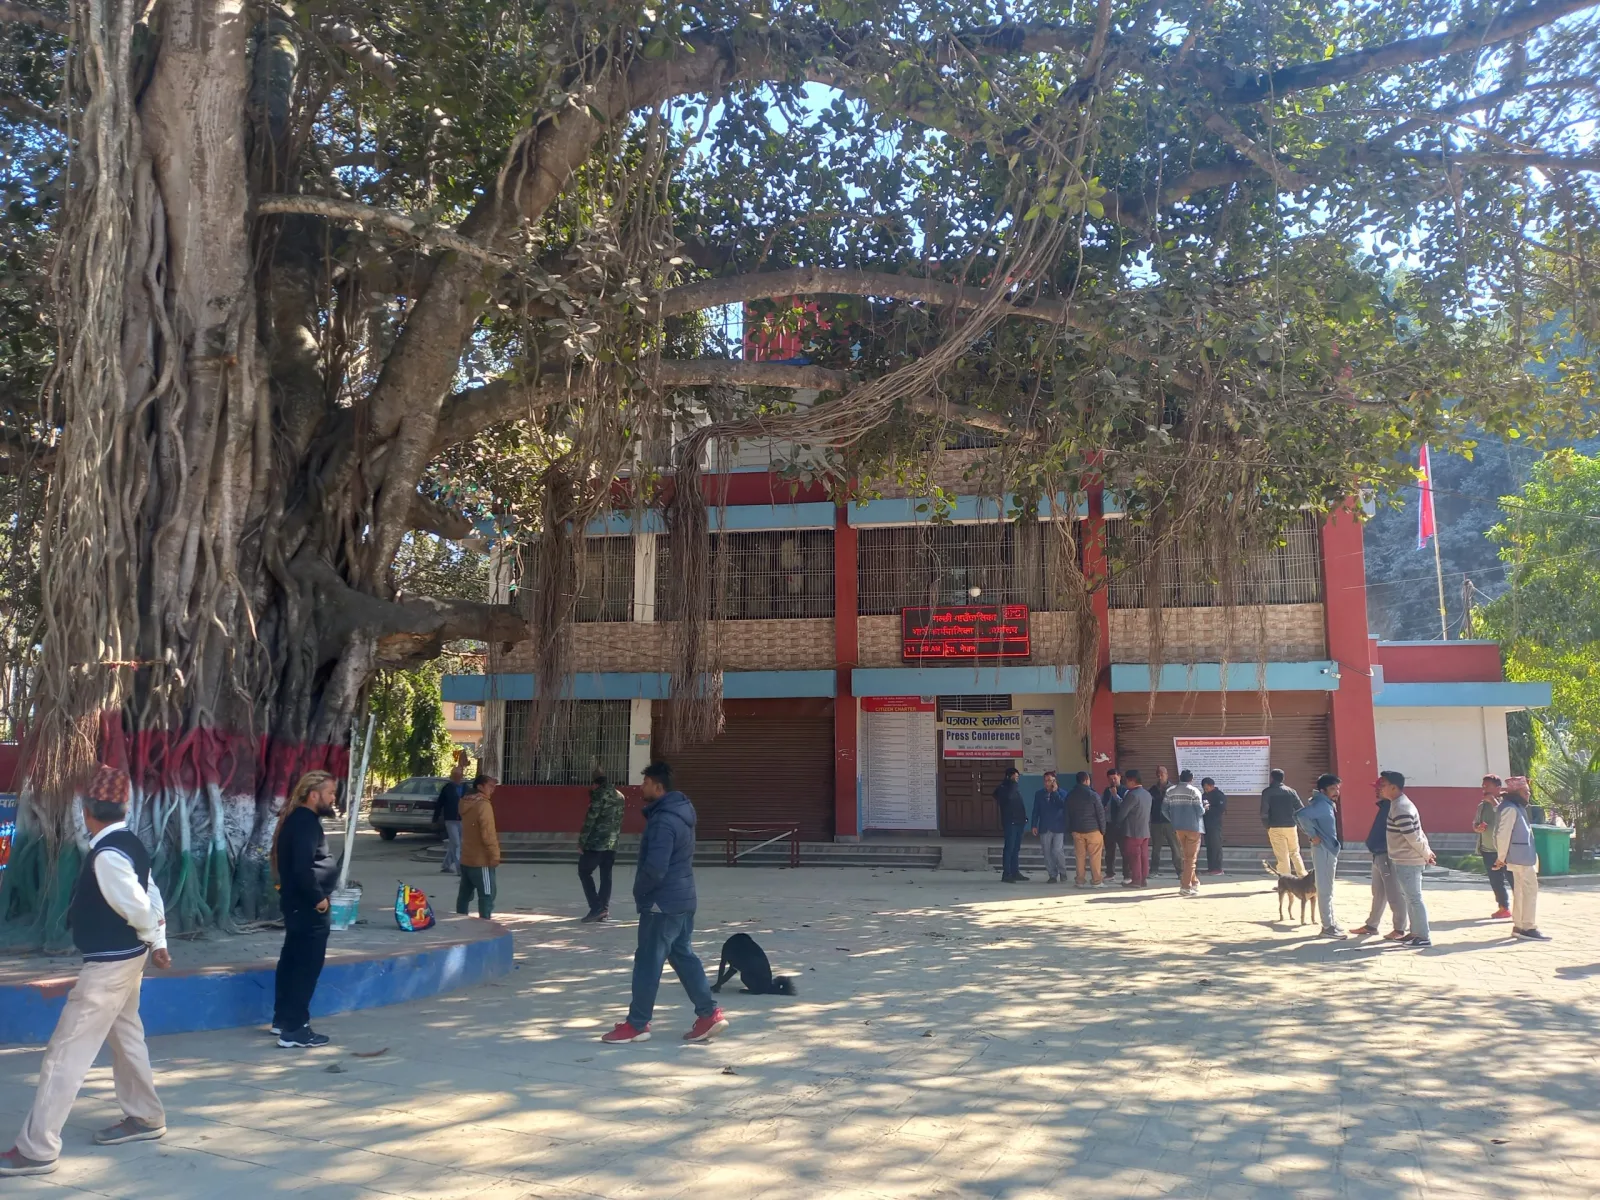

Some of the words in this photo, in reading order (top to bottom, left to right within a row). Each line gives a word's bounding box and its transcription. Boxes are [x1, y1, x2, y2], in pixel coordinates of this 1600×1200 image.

[946, 716, 978, 726] पत्रकार
[981, 714, 1020, 727] सम्मेलन
[946, 730, 970, 741] Press
[971, 730, 1021, 741] Conference
